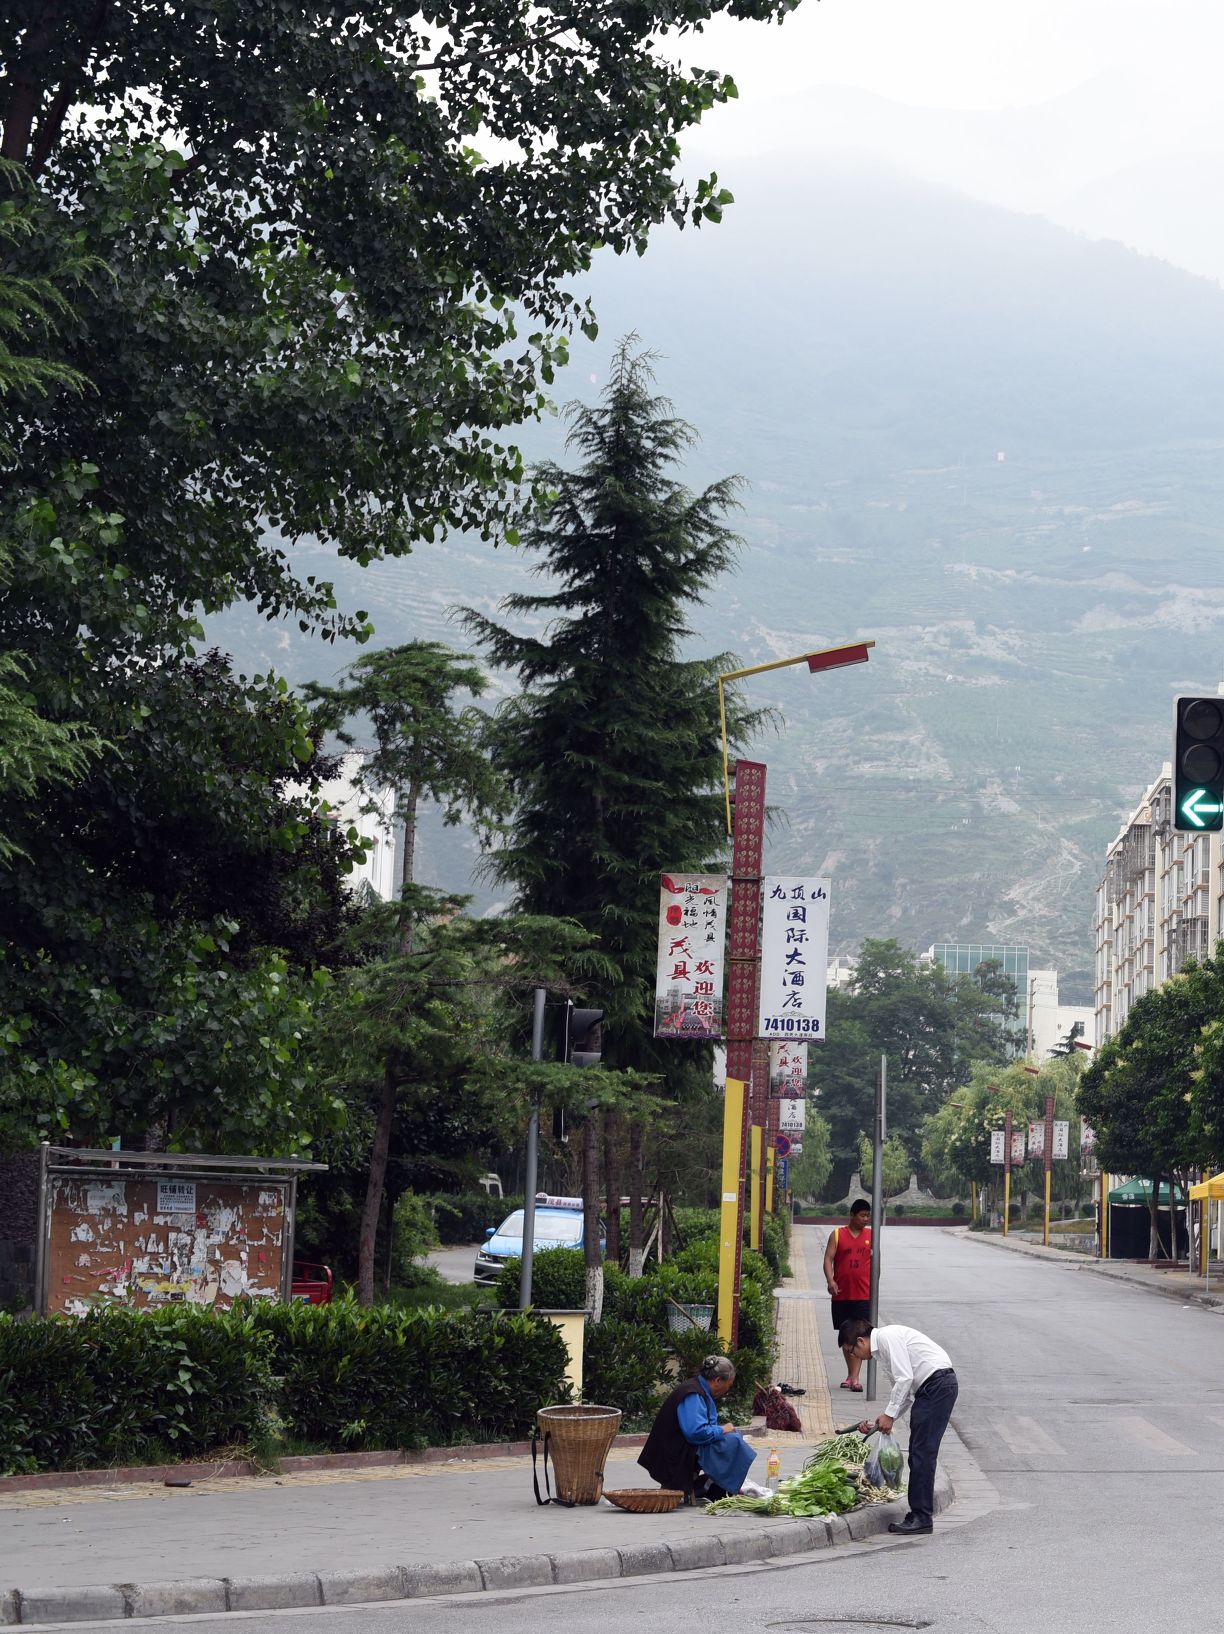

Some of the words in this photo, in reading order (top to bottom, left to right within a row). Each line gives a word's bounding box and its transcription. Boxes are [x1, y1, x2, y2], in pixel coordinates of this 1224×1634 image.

[769, 884, 827, 901] 九顶山
[666, 936, 693, 981] 茂县
[782, 906, 809, 1009] 国际大酒店
[691, 960, 715, 1016] 欢迎您
[763, 1018, 820, 1033] 7410138
[791, 1056, 802, 1087] 欢迎您
[160, 1184, 194, 1195] 旺铺转让
